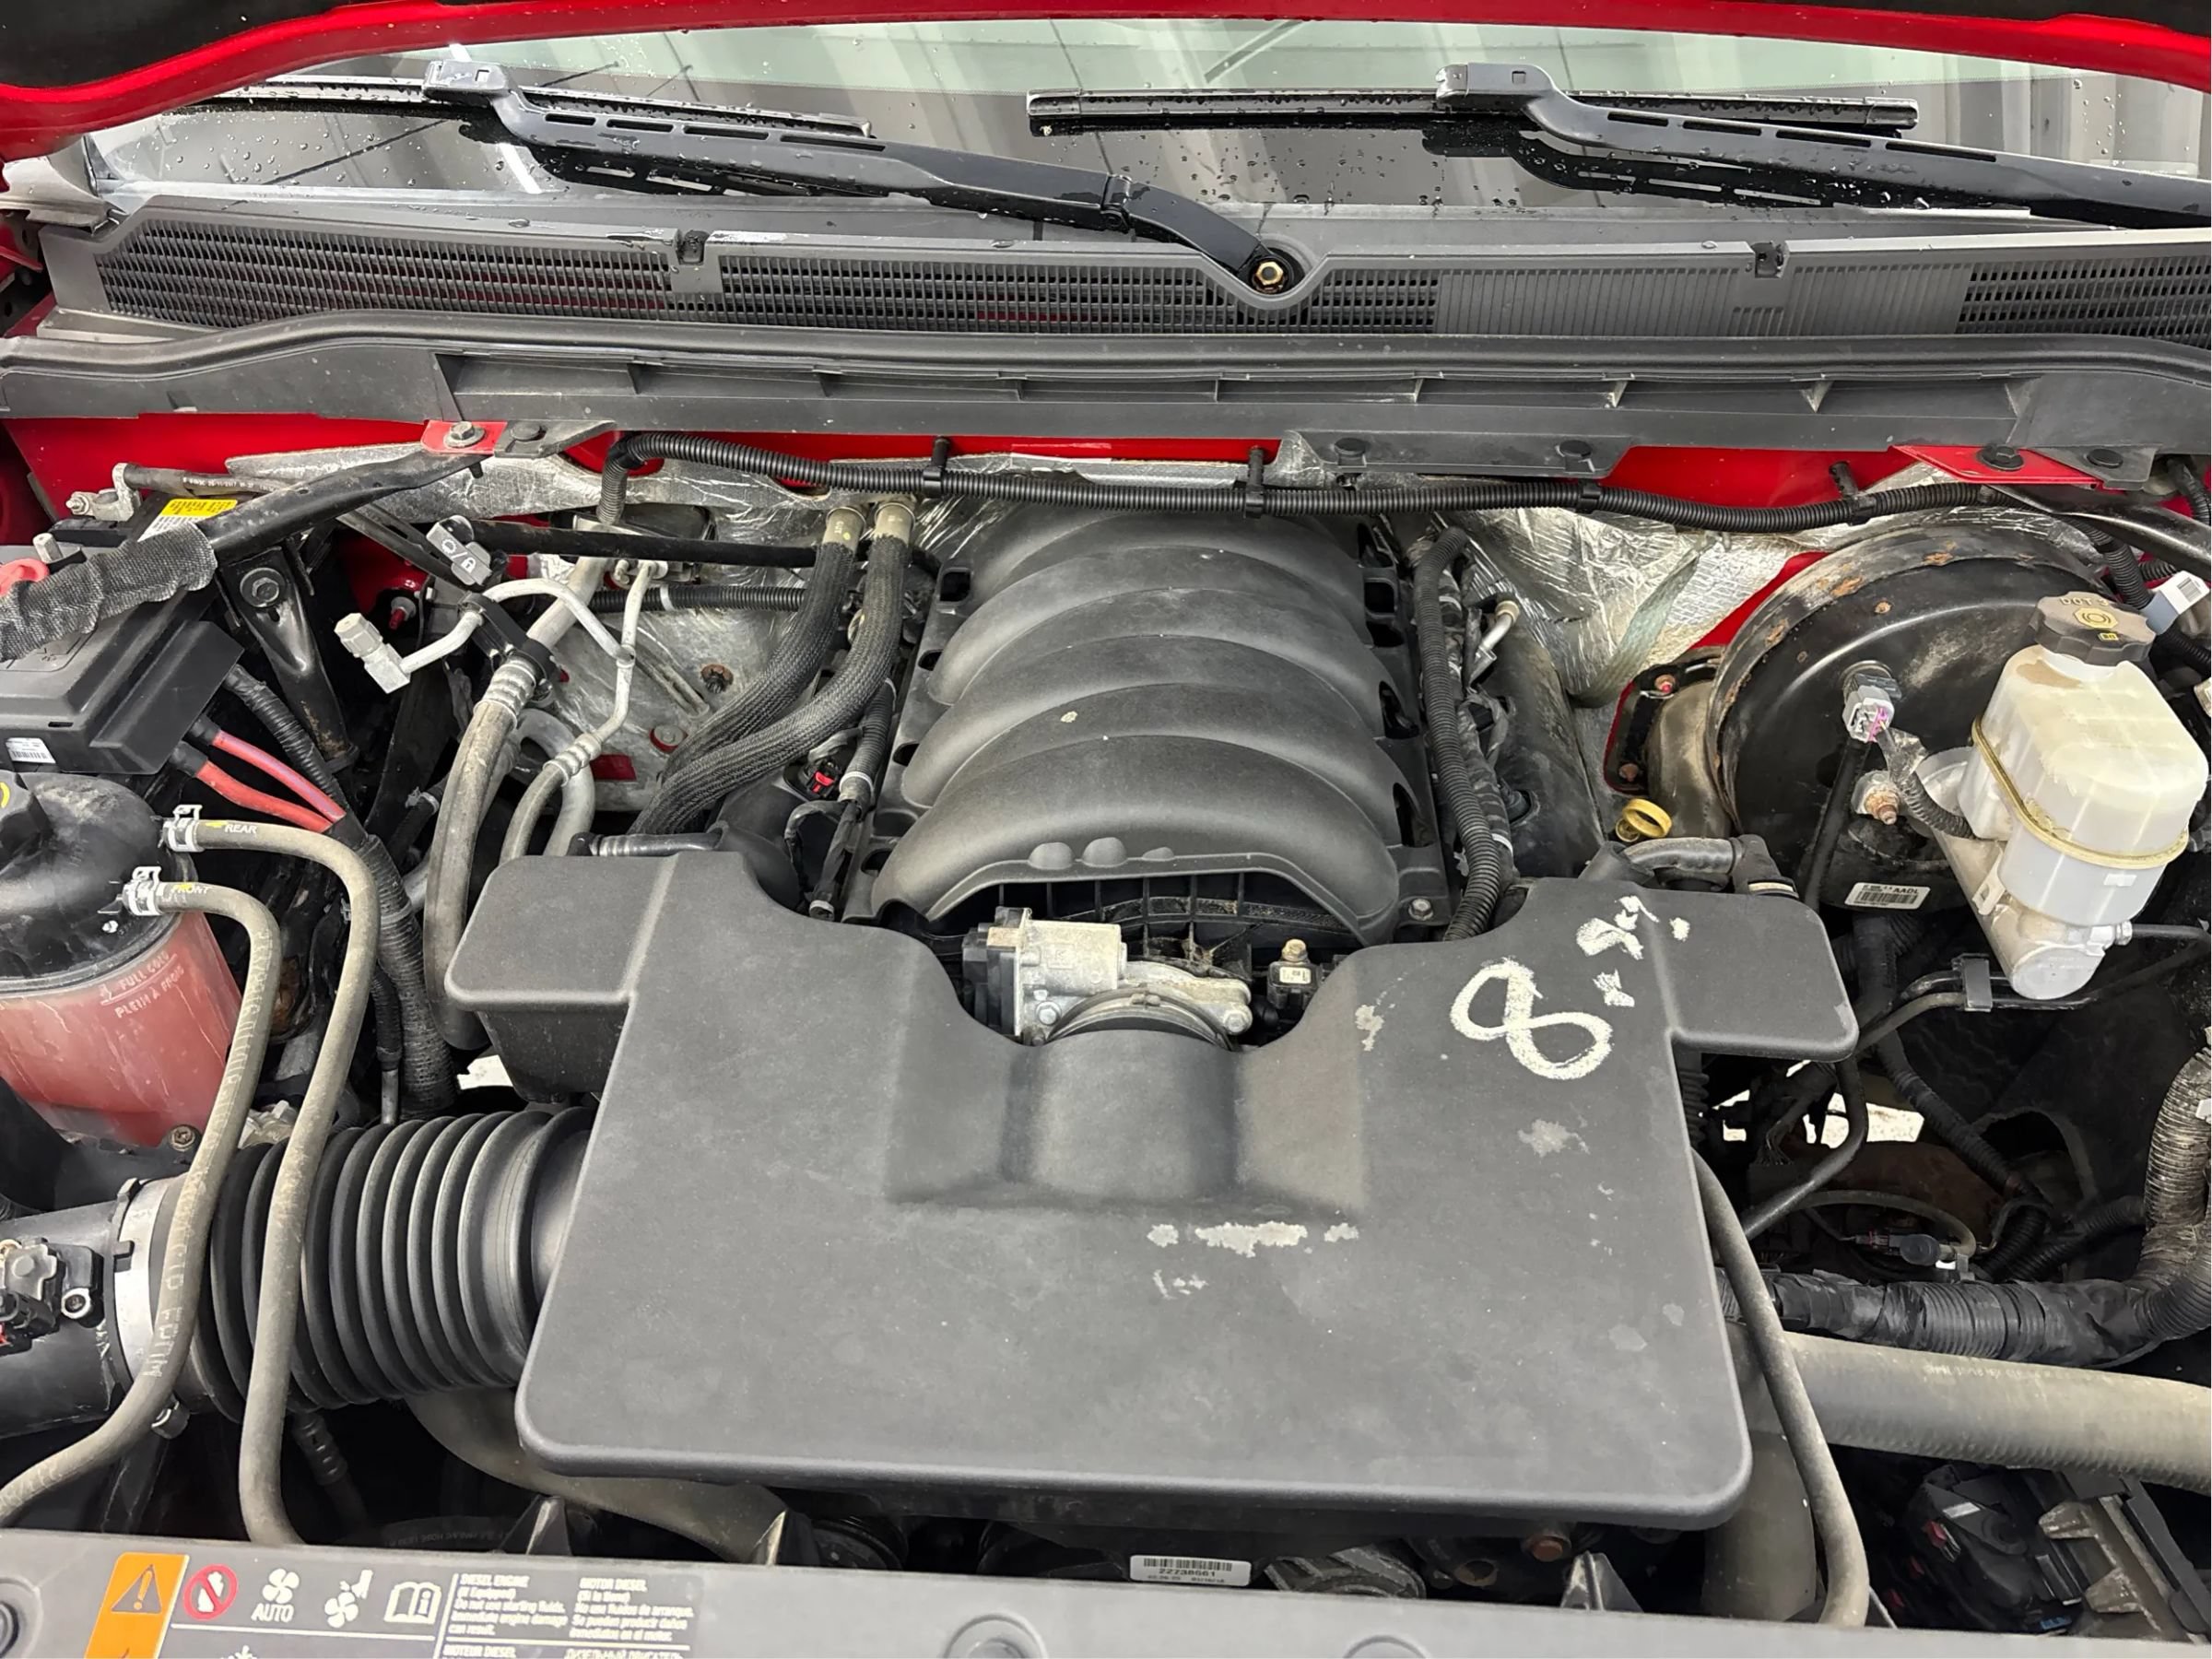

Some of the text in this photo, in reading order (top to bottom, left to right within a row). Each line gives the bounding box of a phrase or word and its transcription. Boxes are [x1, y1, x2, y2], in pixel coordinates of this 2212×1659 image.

[2060, 597, 2110, 606] DOT 3
[225, 824, 258, 835] REAR
[171, 884, 211, 895] FRONT
[119, 951, 170, 990] FULL COLD
[114, 994, 152, 1018] PLEIN
[251, 1603, 295, 1623] AUTO
